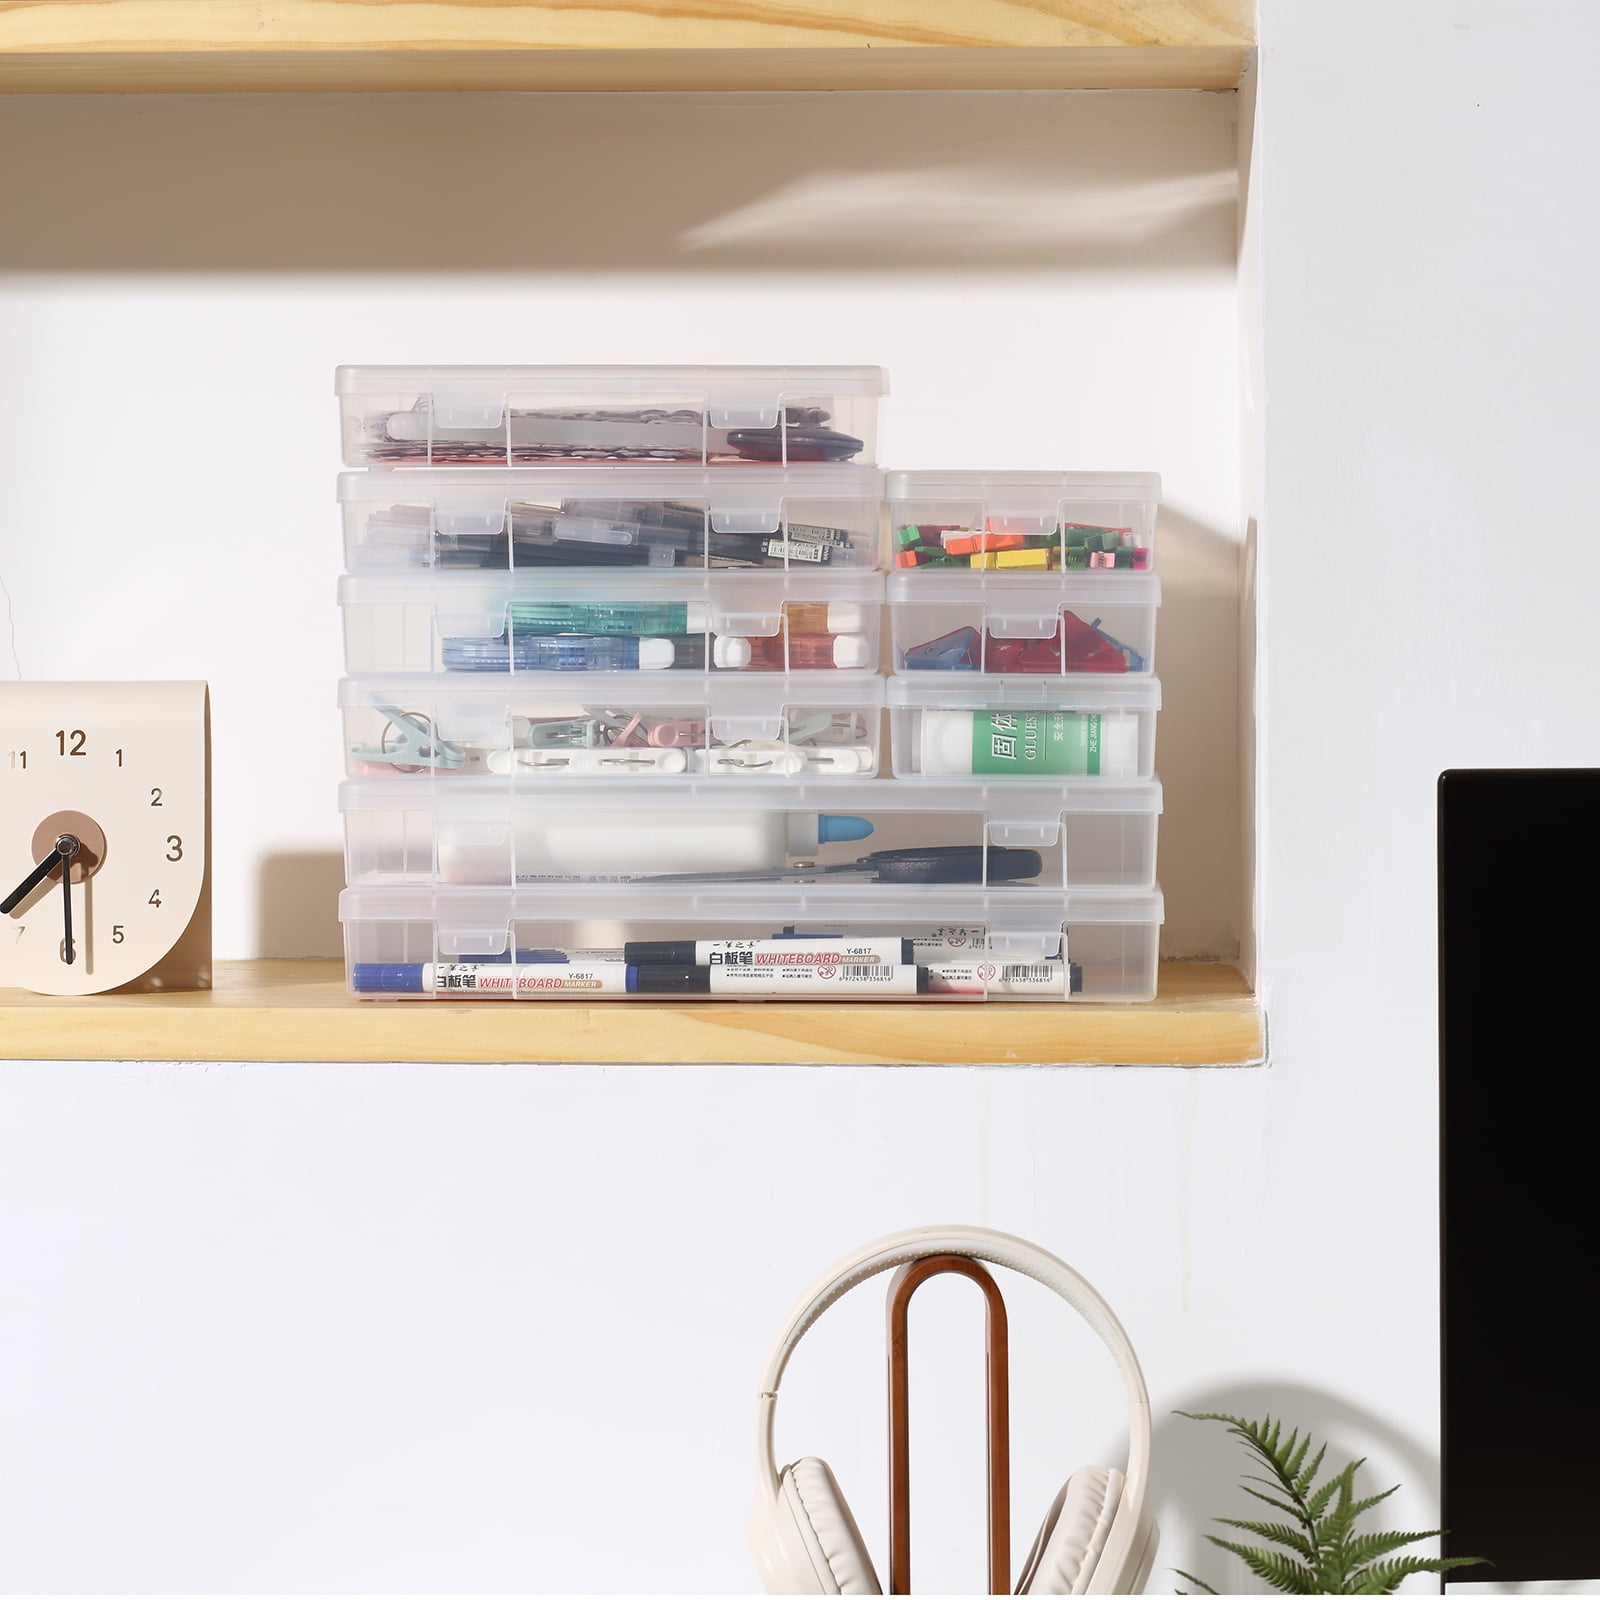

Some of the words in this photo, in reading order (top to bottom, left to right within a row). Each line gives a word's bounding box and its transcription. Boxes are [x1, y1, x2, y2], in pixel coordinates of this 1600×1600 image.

[55, 729, 87, 756] 12
[9, 750, 27, 769] 11
[115, 748, 123, 767] 1
[150, 787, 163, 807] 2
[166, 835, 184, 862] 3
[148, 889, 162, 908] 4
[112, 925, 125, 944] 5
[709, 951, 753, 966] 白板笔
[755, 953, 841, 966] WHITEBOARD
[436, 974, 477, 989] 白板笔
[479, 978, 563, 990] WHITBOARD
[563, 980, 598, 988] MARKER
